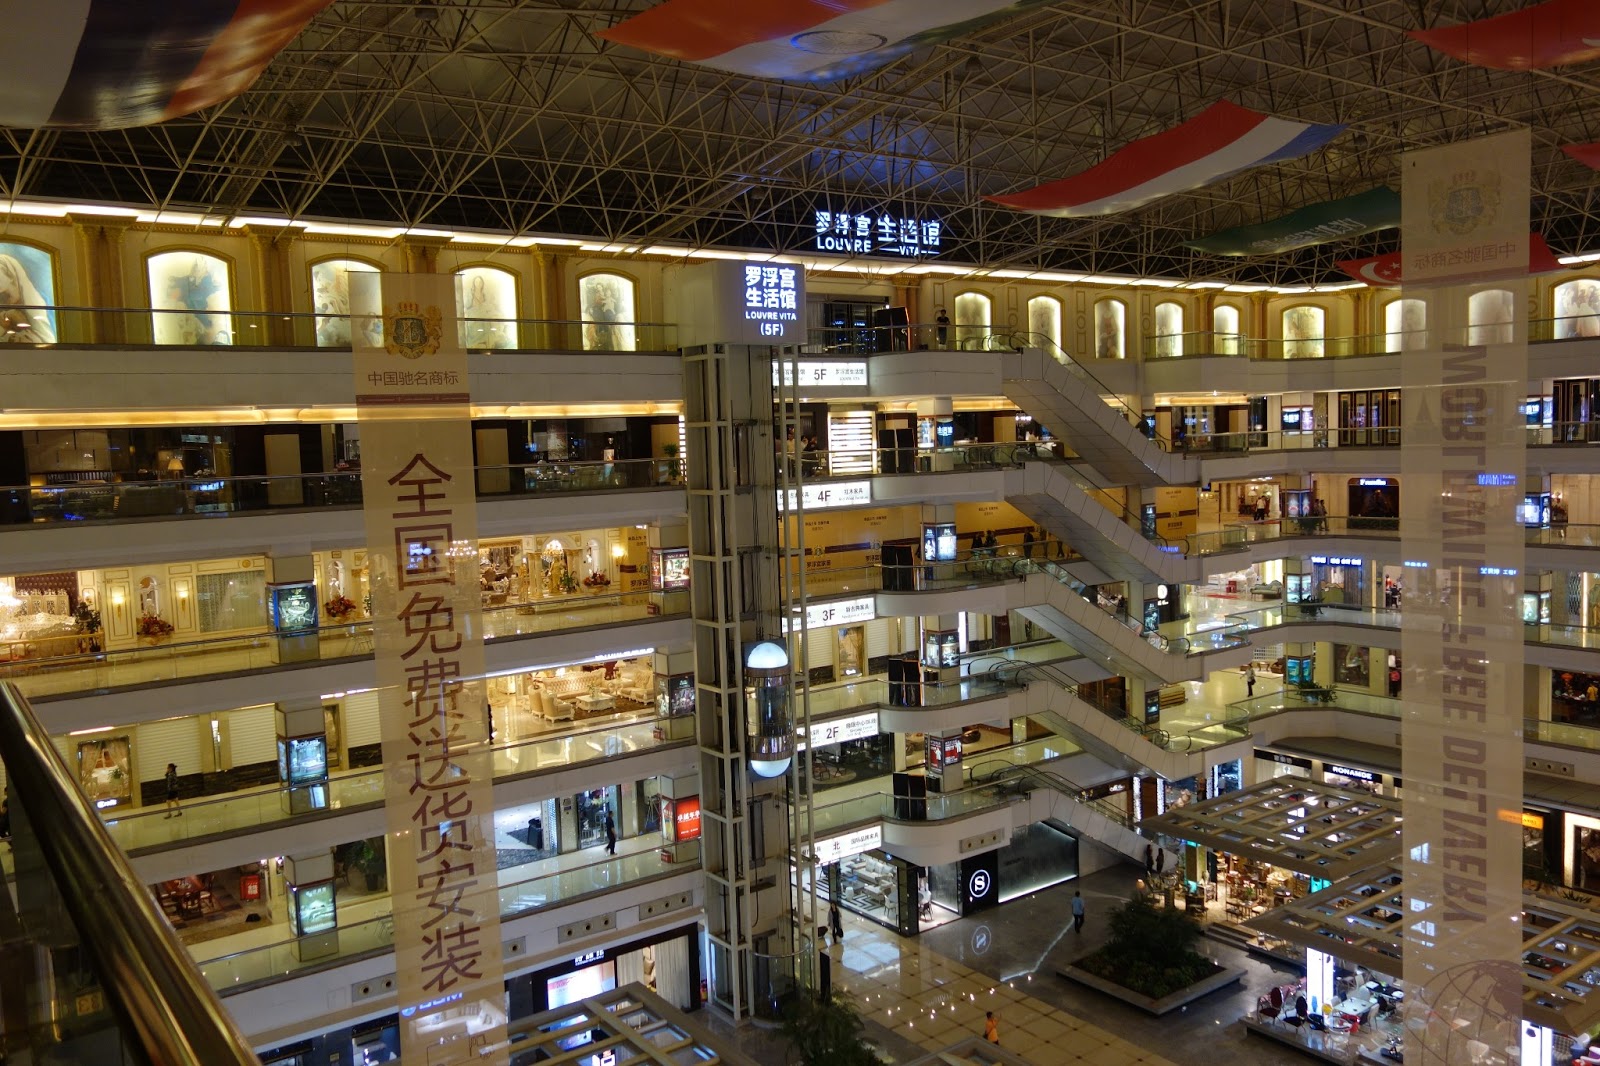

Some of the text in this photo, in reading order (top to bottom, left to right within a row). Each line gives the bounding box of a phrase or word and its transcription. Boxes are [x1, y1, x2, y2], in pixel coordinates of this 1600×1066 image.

[816, 211, 940, 245] 罗浮宫 生活馆
[817, 236, 872, 252] LOUVRE
[745, 265, 796, 288] 罗浮宫
[746, 287, 797, 310] 生活馆
[745, 311, 797, 321] LOUVRE VITA
[760, 323, 784, 336] (5F)
[367, 370, 459, 387] 中国驰名商标
[813, 368, 827, 381] 5F
[817, 490, 831, 502] 4F
[822, 608, 836, 621] 3F
[388, 452, 484, 993] 全国免费送货安装
[826, 726, 839, 740] 2F
[833, 841, 841, 851] 北
